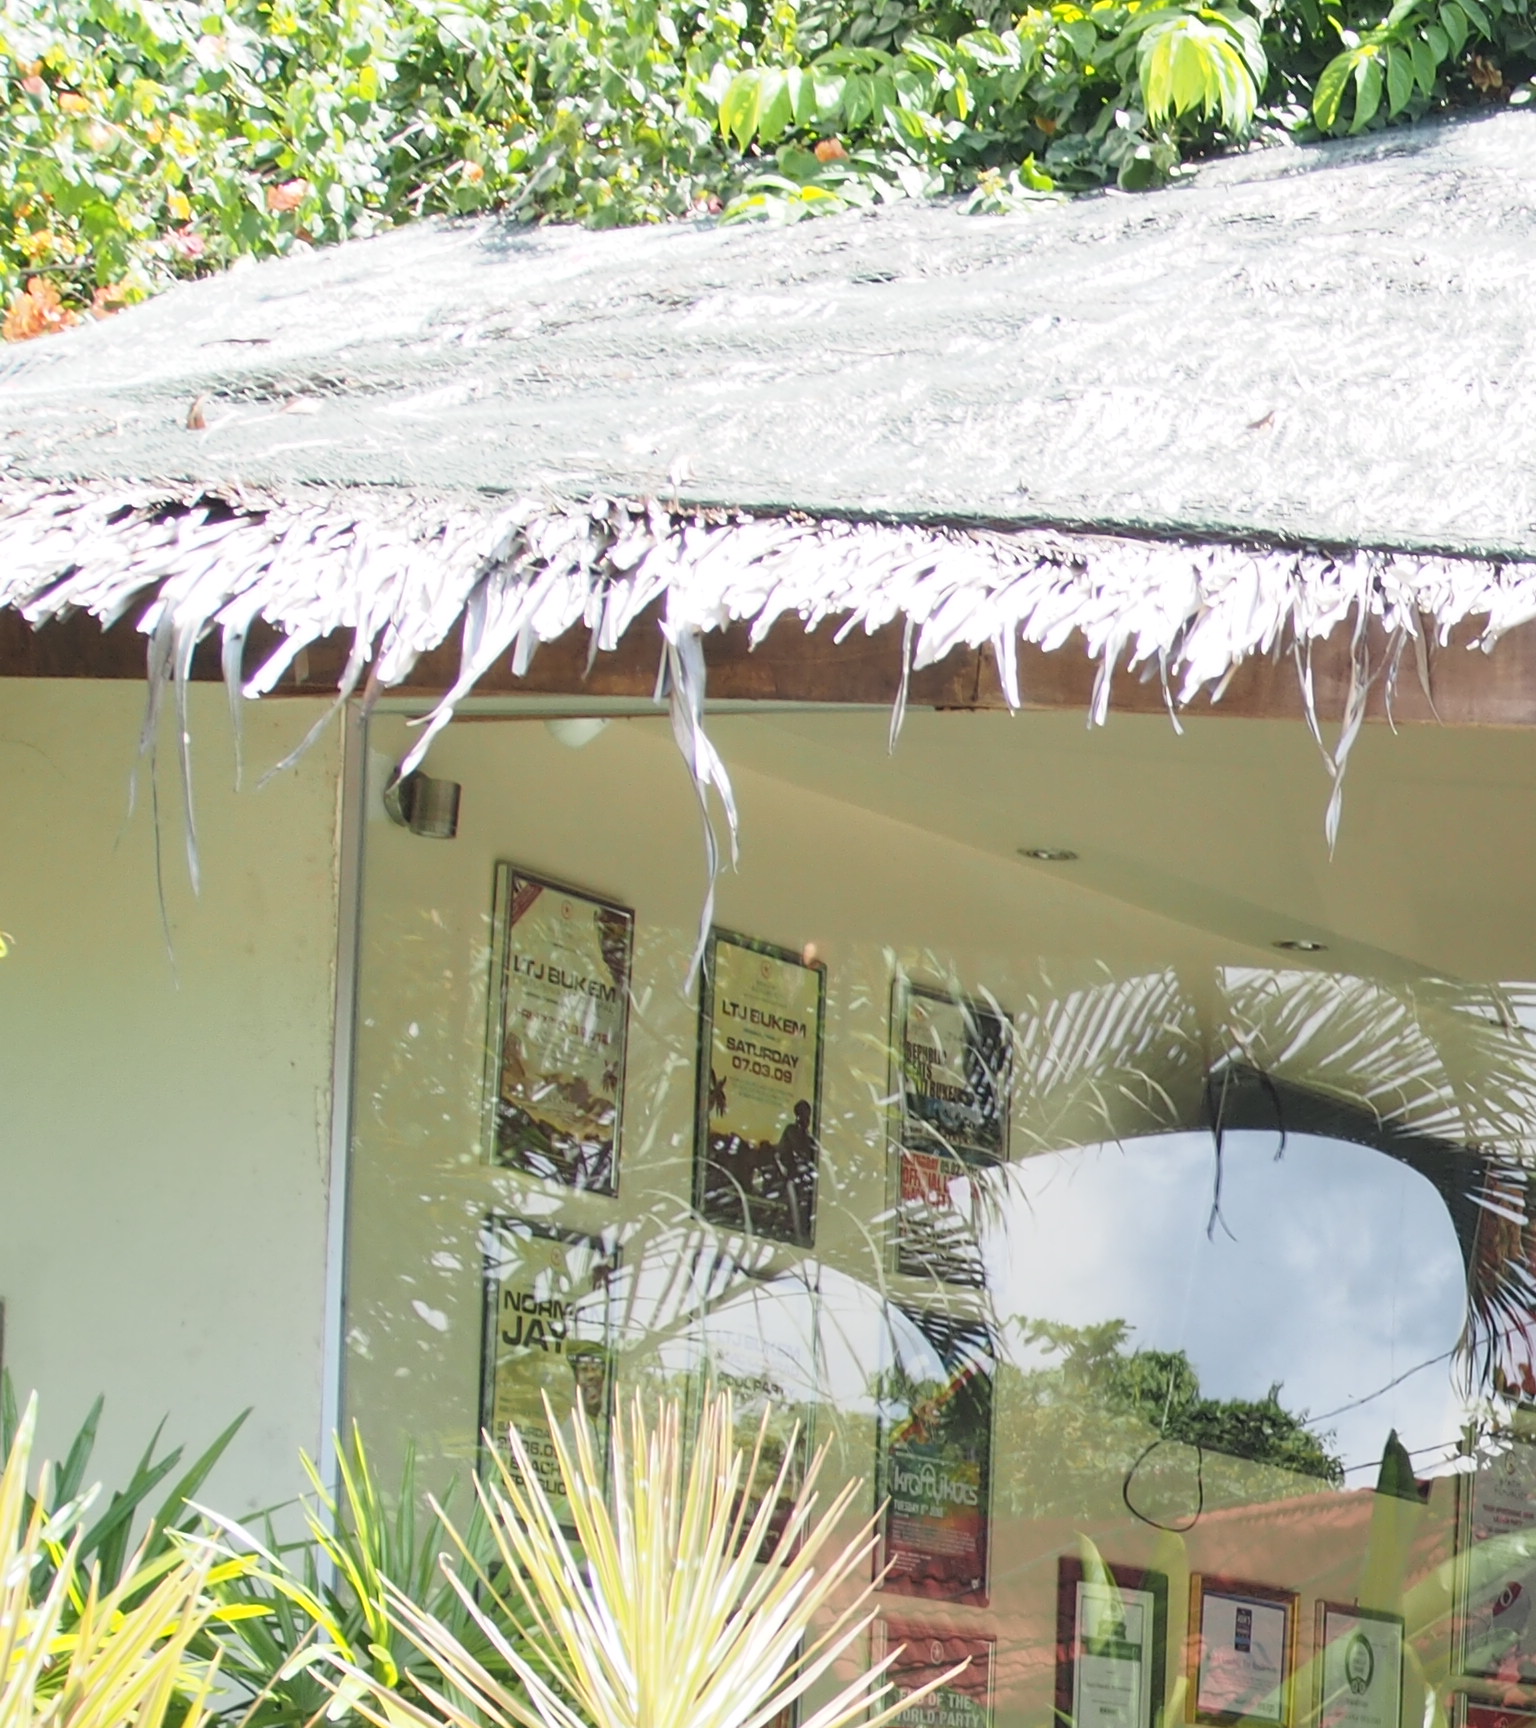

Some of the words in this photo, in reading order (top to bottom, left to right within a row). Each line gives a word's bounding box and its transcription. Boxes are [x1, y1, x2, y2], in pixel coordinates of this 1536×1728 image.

[513, 954, 546, 980] LTJ
[547, 966, 617, 1003] BUKEM
[722, 999, 748, 1020] LTJ
[749, 1007, 806, 1038] BUKEM
[726, 1036, 799, 1068] SATURDAY
[731, 1055, 793, 1084] 07.03.09
[501, 1315, 569, 1354] JAY
[947, 1693, 972, 1710] THE
[939, 1711, 981, 1728] PARTY
